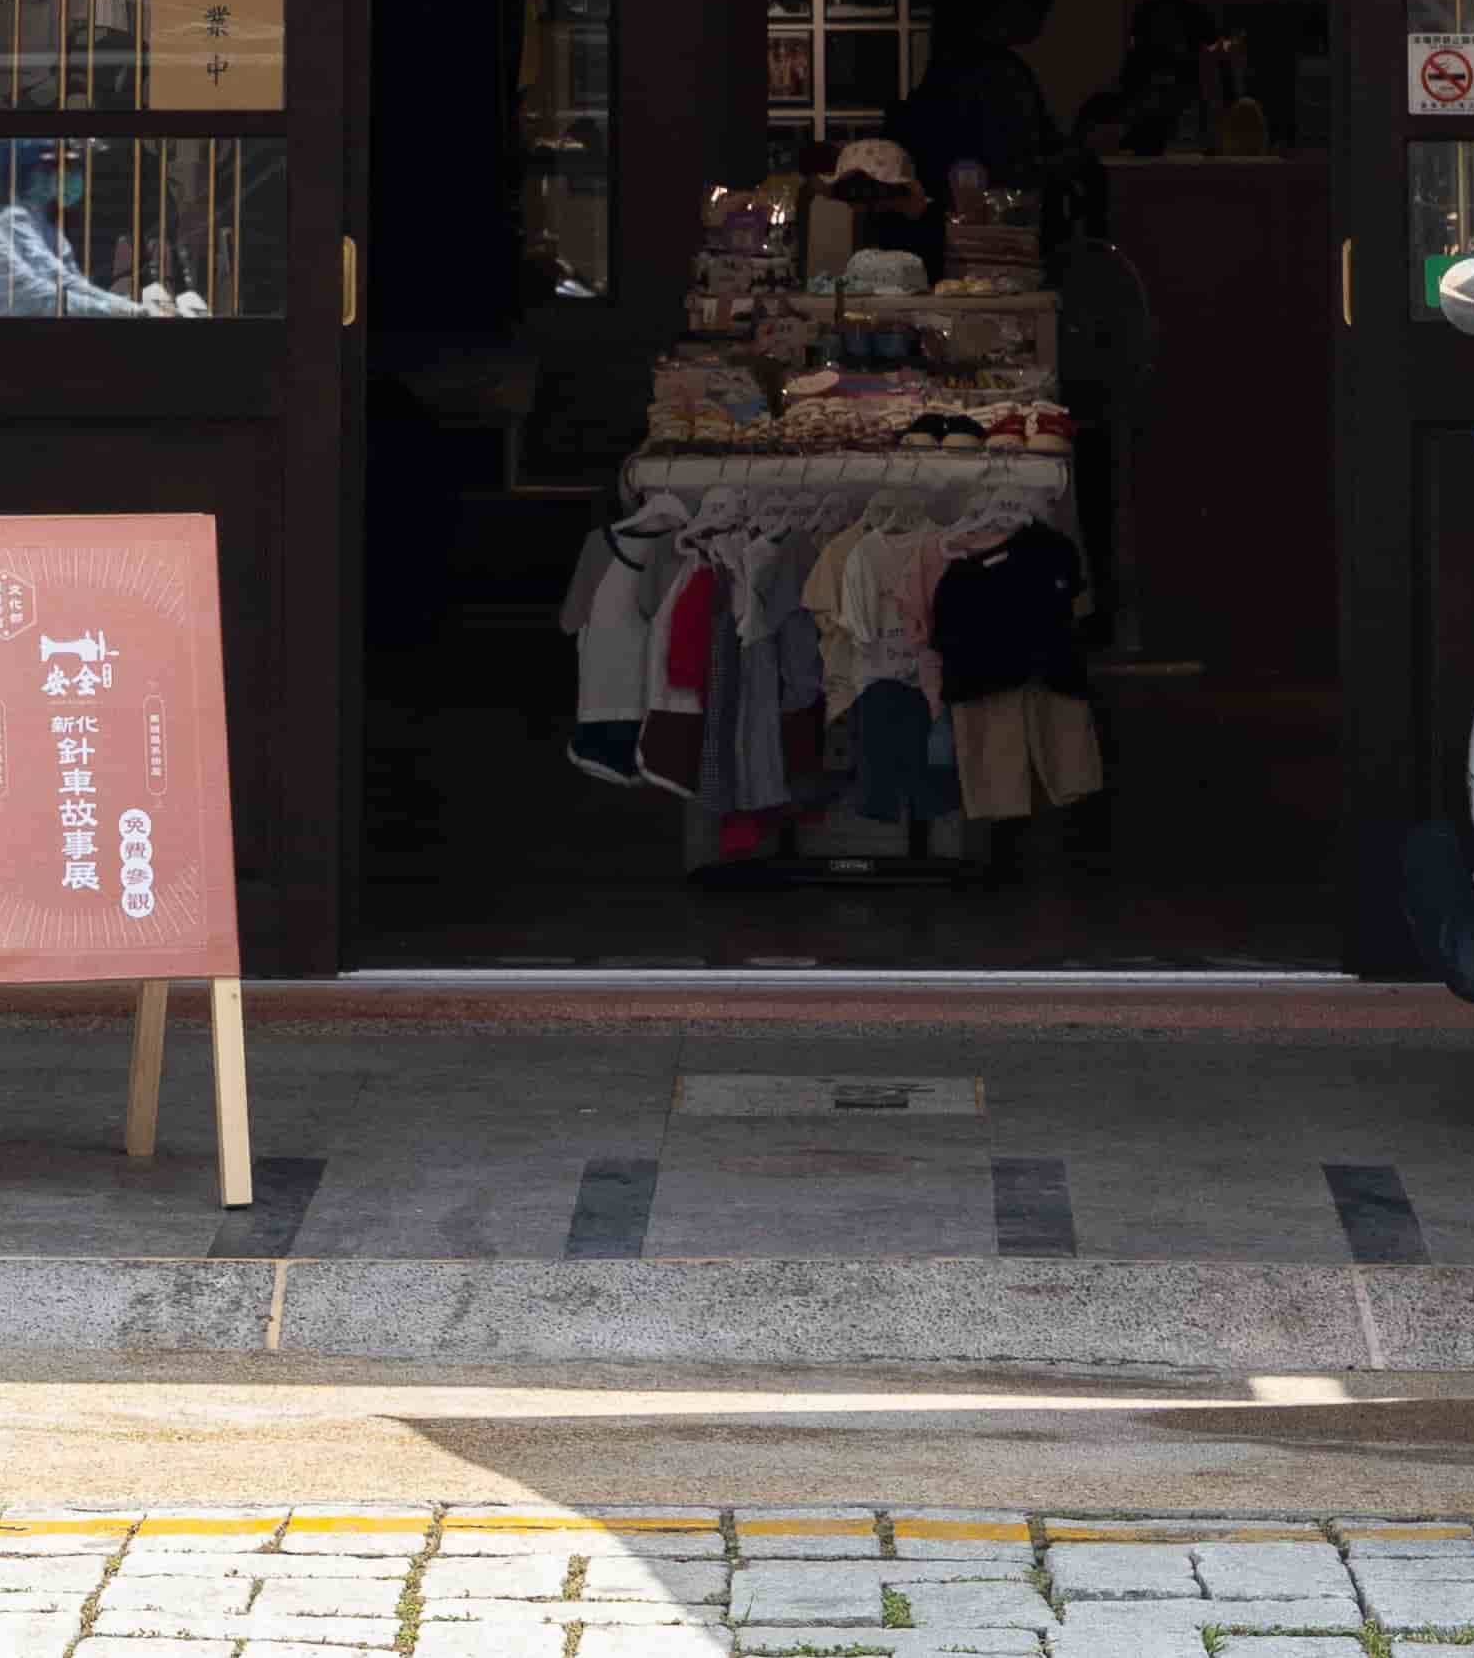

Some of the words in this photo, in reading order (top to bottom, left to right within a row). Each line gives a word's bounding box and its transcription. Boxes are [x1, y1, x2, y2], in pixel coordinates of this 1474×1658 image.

[40, 664, 102, 696] 安全
[51, 715, 100, 733] 新化
[57, 736, 101, 891] 針車故事展
